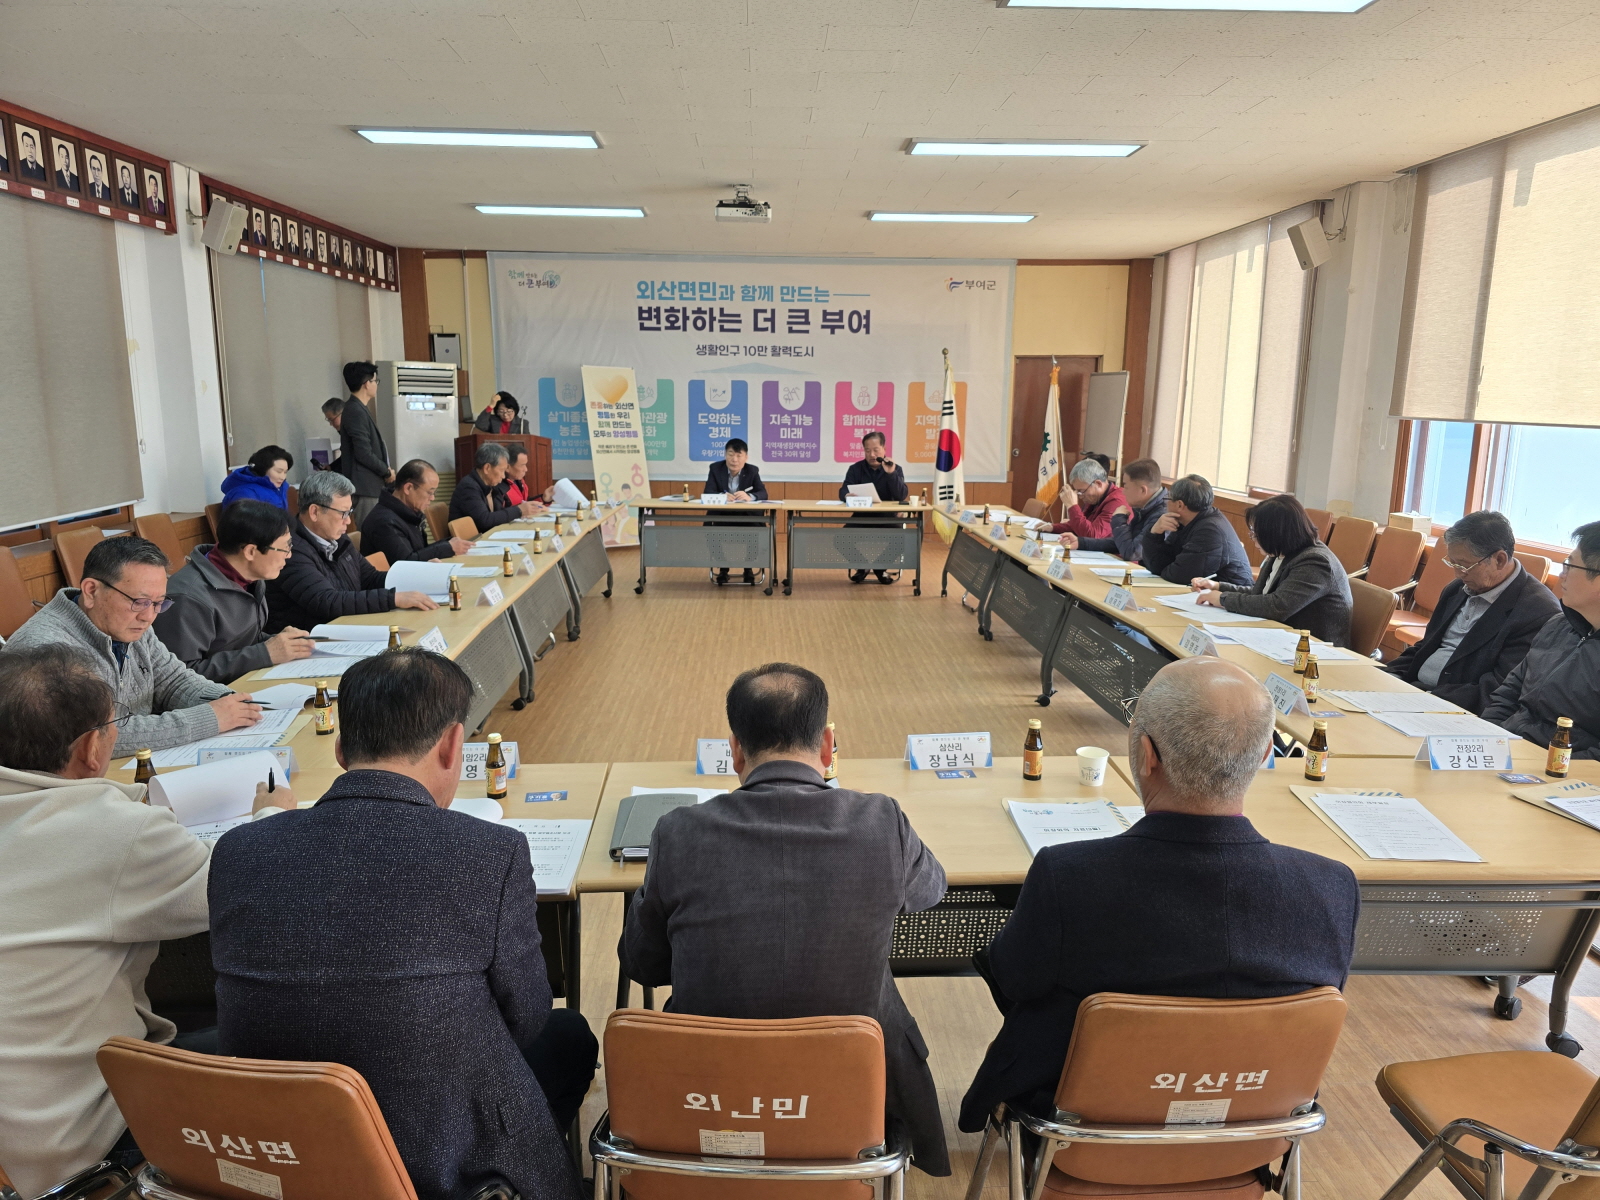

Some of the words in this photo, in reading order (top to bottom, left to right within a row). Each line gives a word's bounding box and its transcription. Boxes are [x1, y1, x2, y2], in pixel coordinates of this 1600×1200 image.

[965, 279, 996, 291] 부여군
[636, 281, 735, 302] 외산면민과
[740, 285, 774, 302] 함께
[780, 285, 830, 303] 만드는
[638, 306, 742, 333] 변화하는
[753, 308, 776, 334] 더
[786, 308, 811, 334] 큰
[820, 309, 871, 335] 부여
[696, 344, 740, 357] 생활인구
[743, 345, 768, 357] 10만
[770, 346, 815, 358] 활력도시
[615, 402, 635, 410] 외산면
[548, 411, 589, 423] 살기좋은
[617, 411, 631, 419] 우리
[697, 413, 742, 425] 도약하는
[769, 414, 813, 426] 지속가능
[842, 414, 887, 427] 함께하는
[559, 425, 581, 437] 농촌
[612, 421, 632, 429] 만드는
[593, 430, 612, 438] 모두의
[612, 430, 639, 438] 양성평등
[708, 427, 731, 438] 경제
[779, 427, 803, 439] 미래
[771, 450, 783, 458] 전국
[784, 450, 798, 458] 30위
[799, 450, 811, 458] 달성
[939, 742, 963, 752] 삼산리
[1456, 744, 1485, 753] 전장2리
[462, 752, 487, 762] 암2리
[928, 753, 975, 768] 장남식
[1448, 755, 1495, 769] 강신문
[1150, 1069, 1269, 1094] 외산면
[181, 1126, 301, 1165] 외산면
